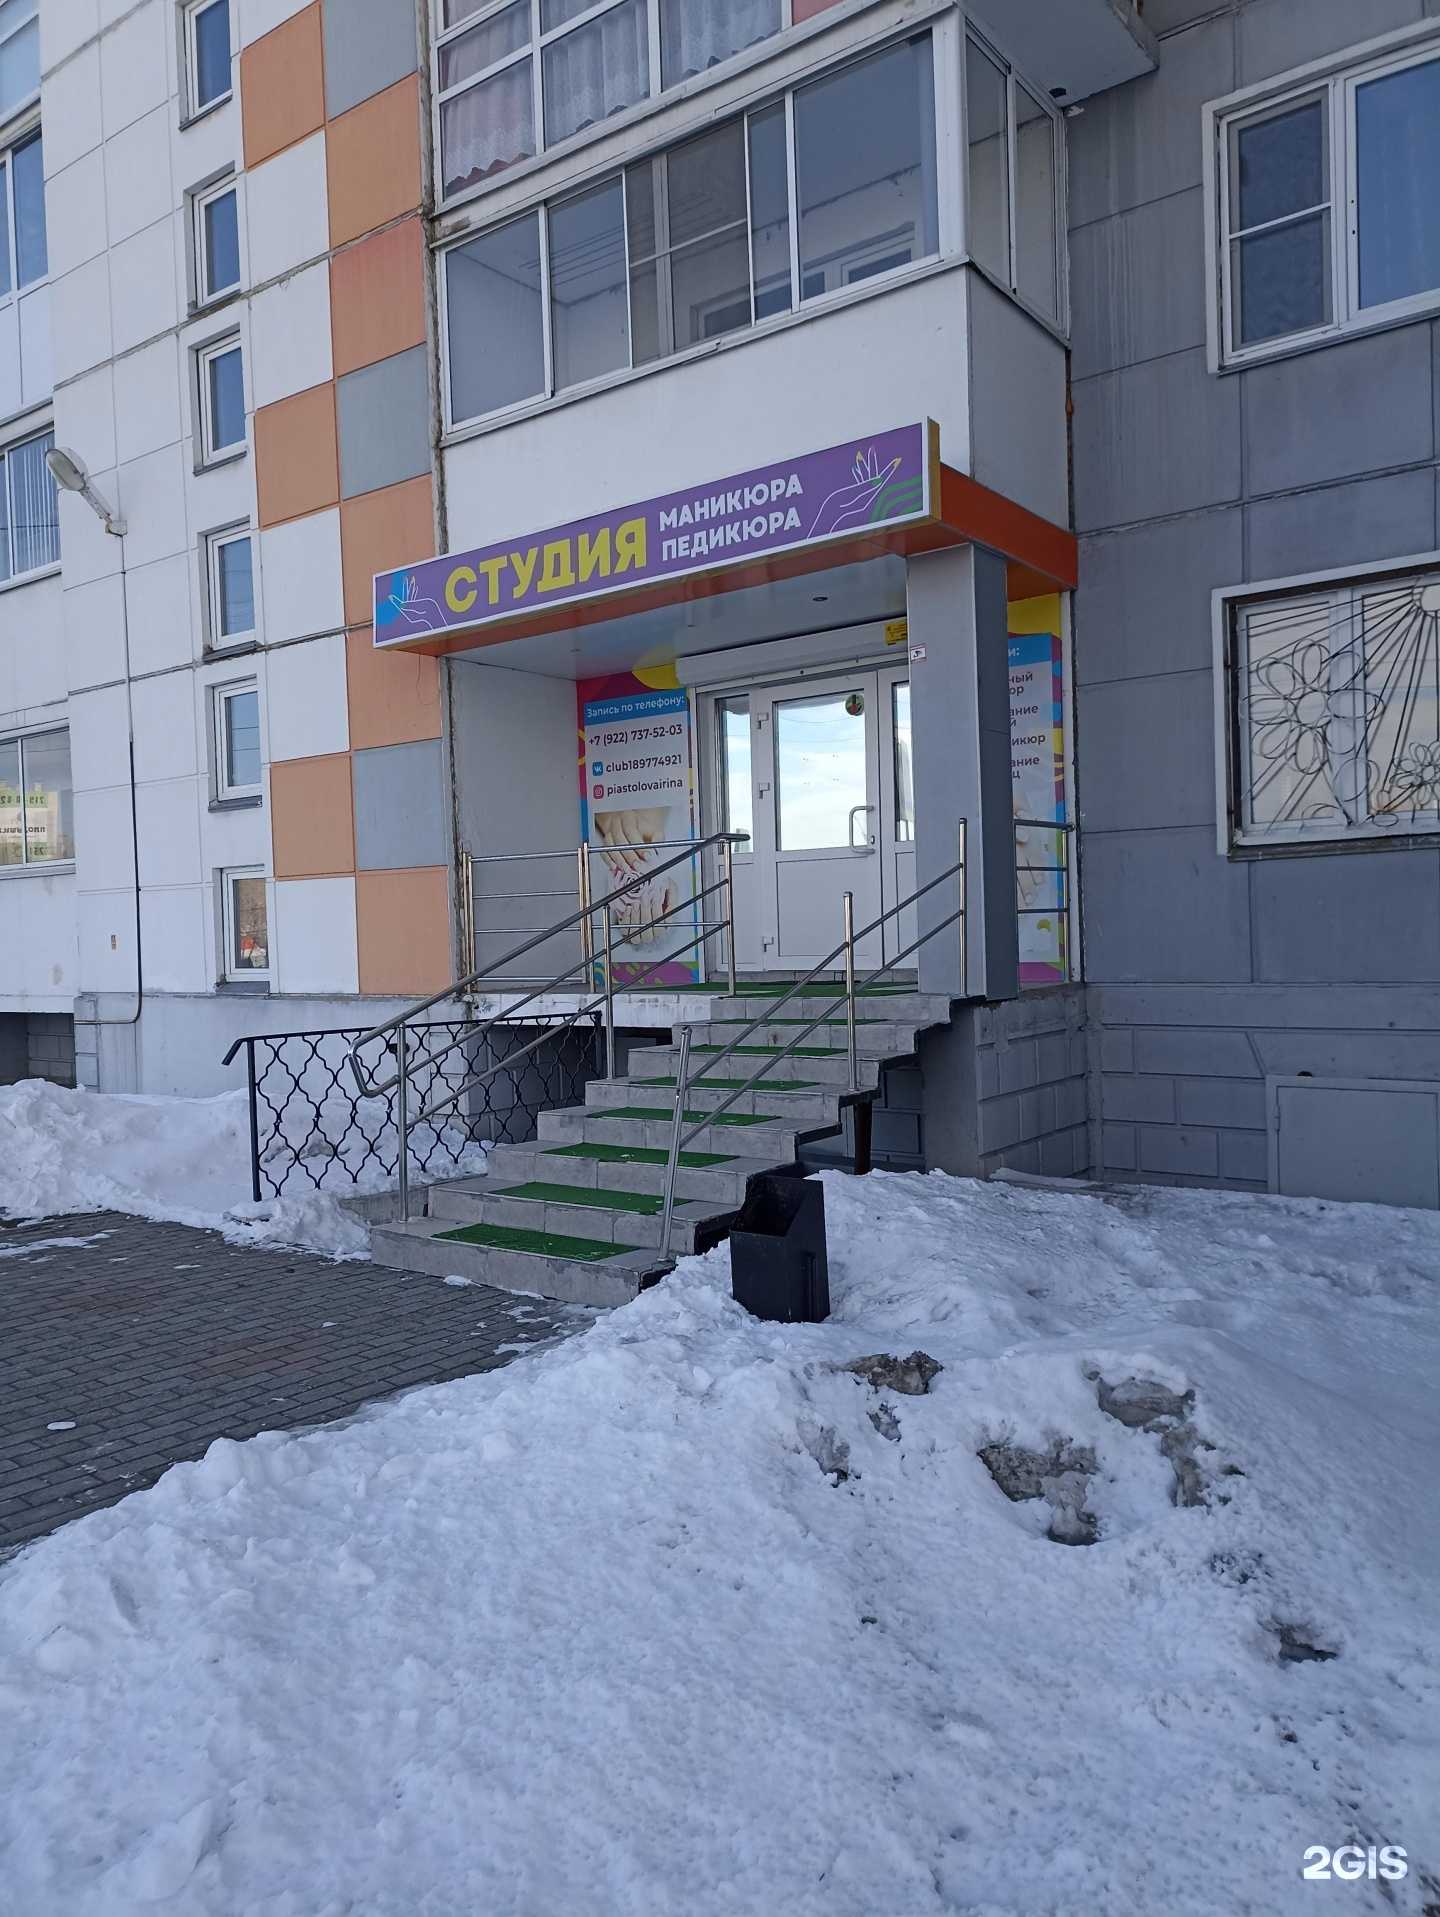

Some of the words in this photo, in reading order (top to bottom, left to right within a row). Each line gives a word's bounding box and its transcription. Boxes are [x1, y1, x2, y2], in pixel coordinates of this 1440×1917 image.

[659, 474, 803, 532] МАНИКЮРА
[662, 507, 801, 561] ПЕДИКЮРА
[445, 517, 647, 613] СТУДИЯ
[587, 705, 620, 718] Запись
[621, 703, 633, 713] по
[635, 695, 685, 710] телефону:
[589, 735, 600, 746] +7
[603, 732, 628, 746] (922)
[631, 724, 683, 741] 737-52-03
[606, 754, 682, 773] club189774921
[607, 778, 683, 797] piastolovairina
